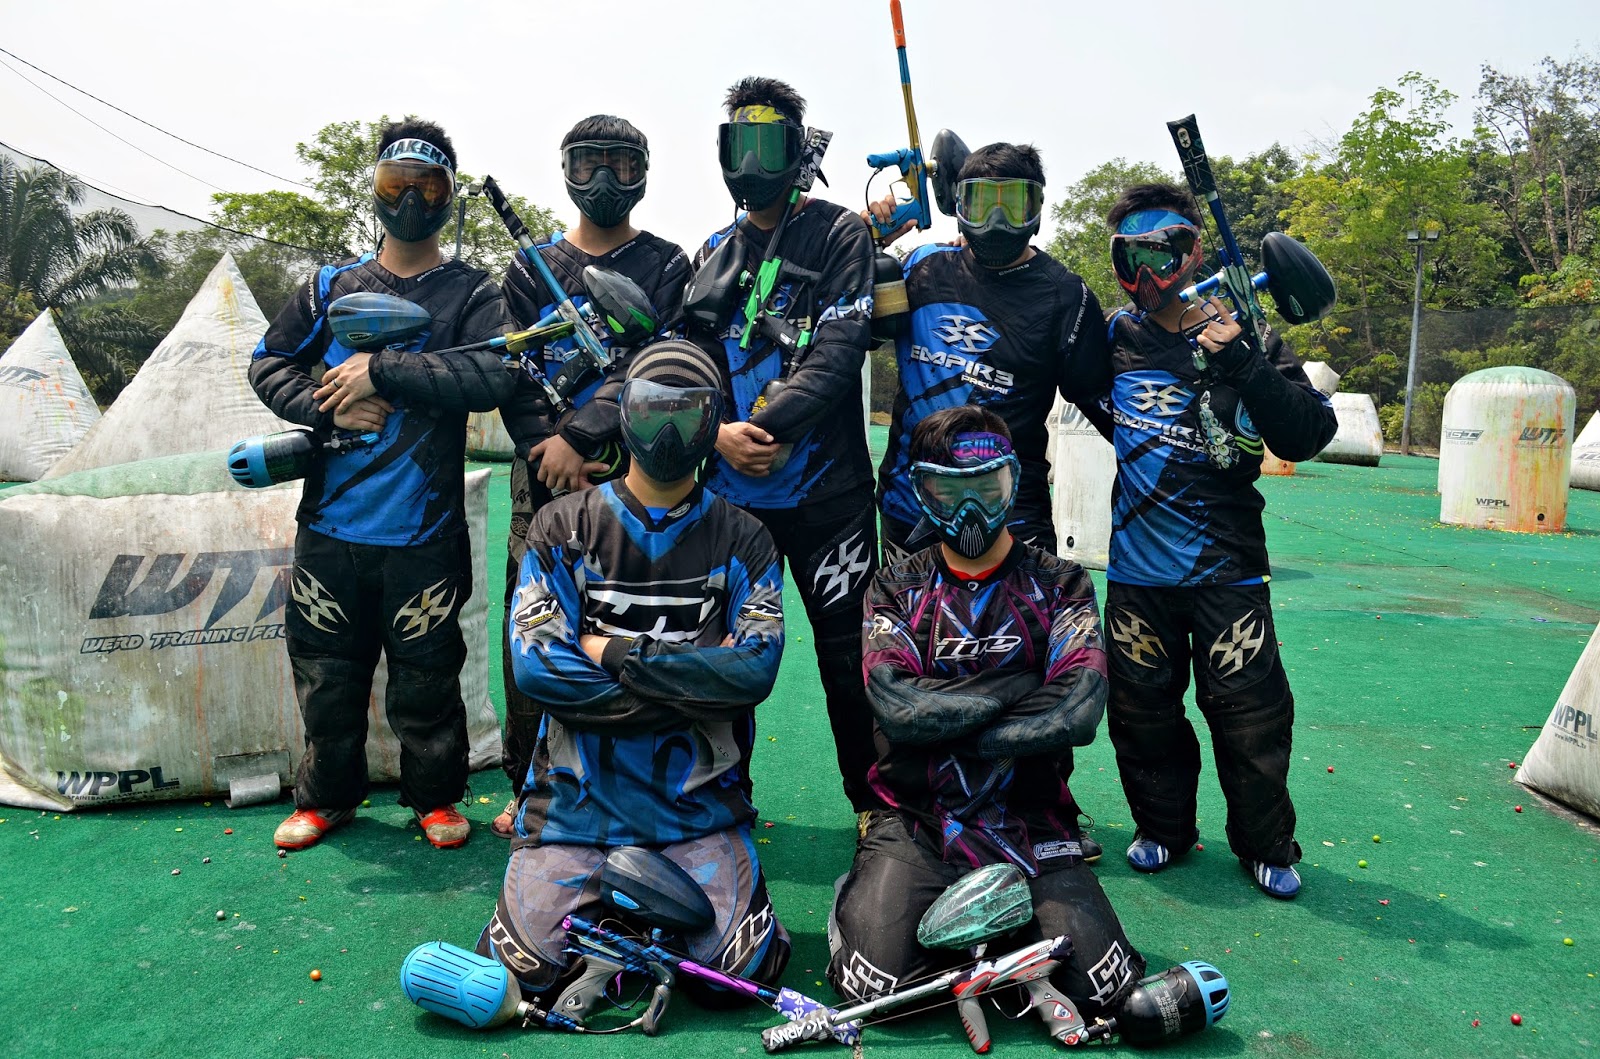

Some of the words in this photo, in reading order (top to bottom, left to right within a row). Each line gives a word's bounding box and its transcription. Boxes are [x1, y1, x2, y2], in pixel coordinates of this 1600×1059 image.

[910, 344, 1014, 387] EMPIRE
[1475, 497, 1510, 507] WPPL
[80, 634, 144, 655] WERD
[150, 627, 249, 650] TRAINING
[57, 766, 180, 795] WPPL
